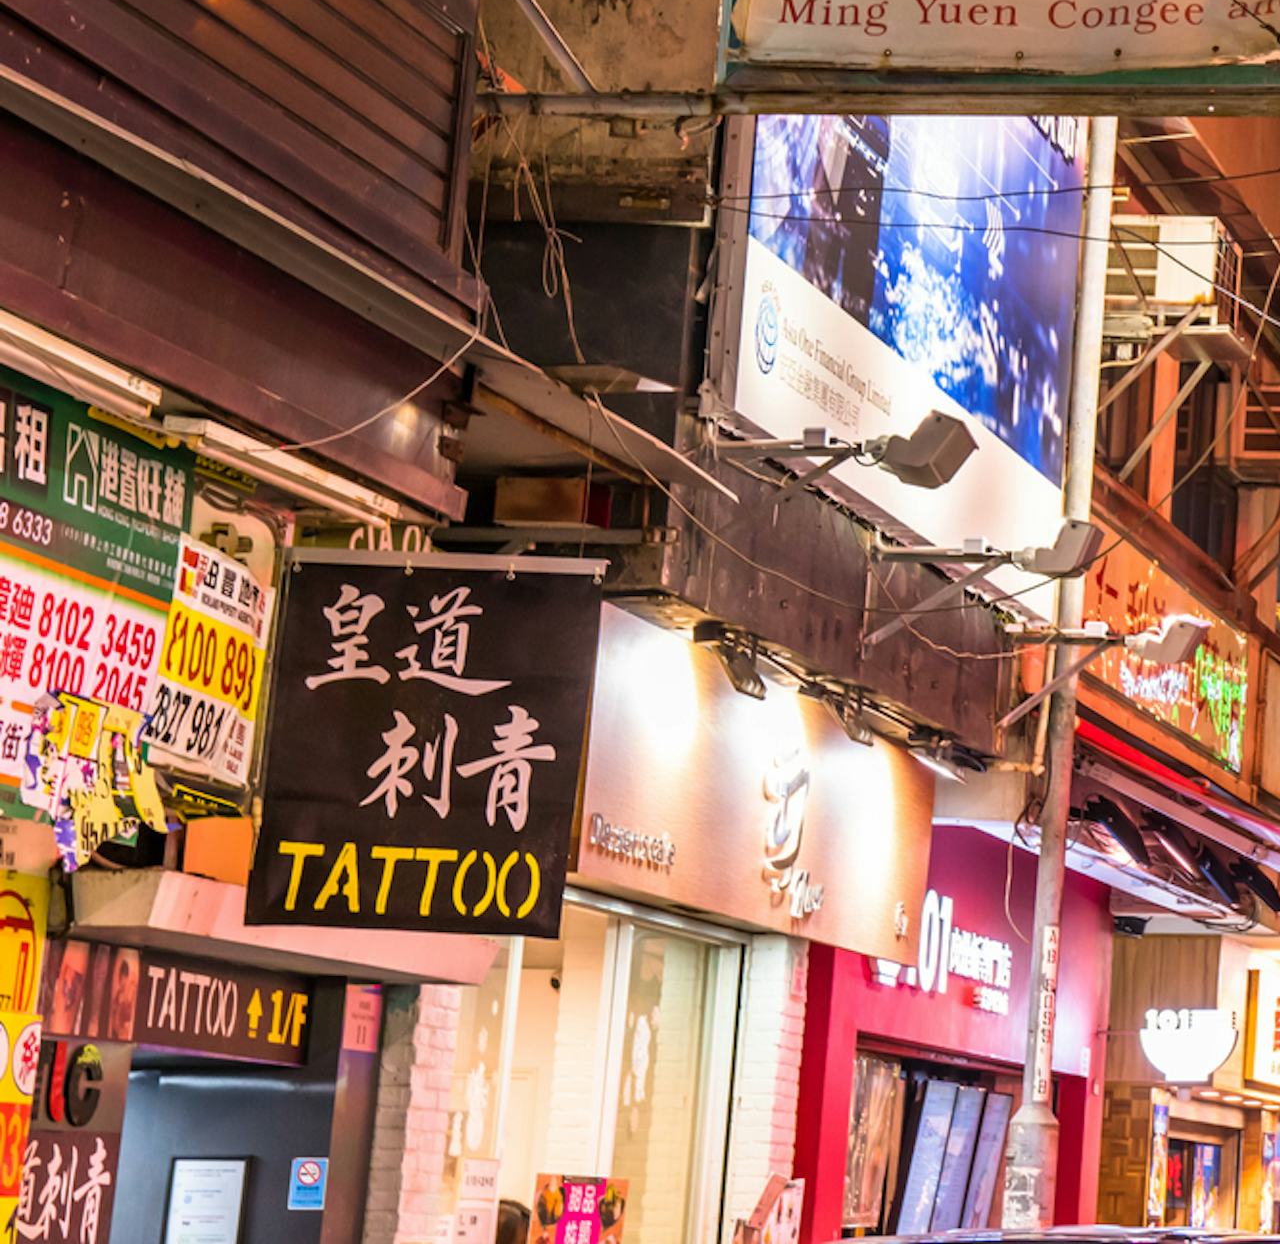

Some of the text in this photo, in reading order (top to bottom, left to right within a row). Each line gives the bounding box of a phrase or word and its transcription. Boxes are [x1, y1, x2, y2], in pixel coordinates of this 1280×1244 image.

[12, 507, 53, 546] 6333
[38, 592, 95, 652] 8102
[100, 613, 157, 671] 3459
[304, 582, 512, 697] 皇道
[358, 704, 558, 834] 刺青
[278, 840, 542, 920] TATTOO
[146, 965, 309, 1048] TATTOO 1/F
